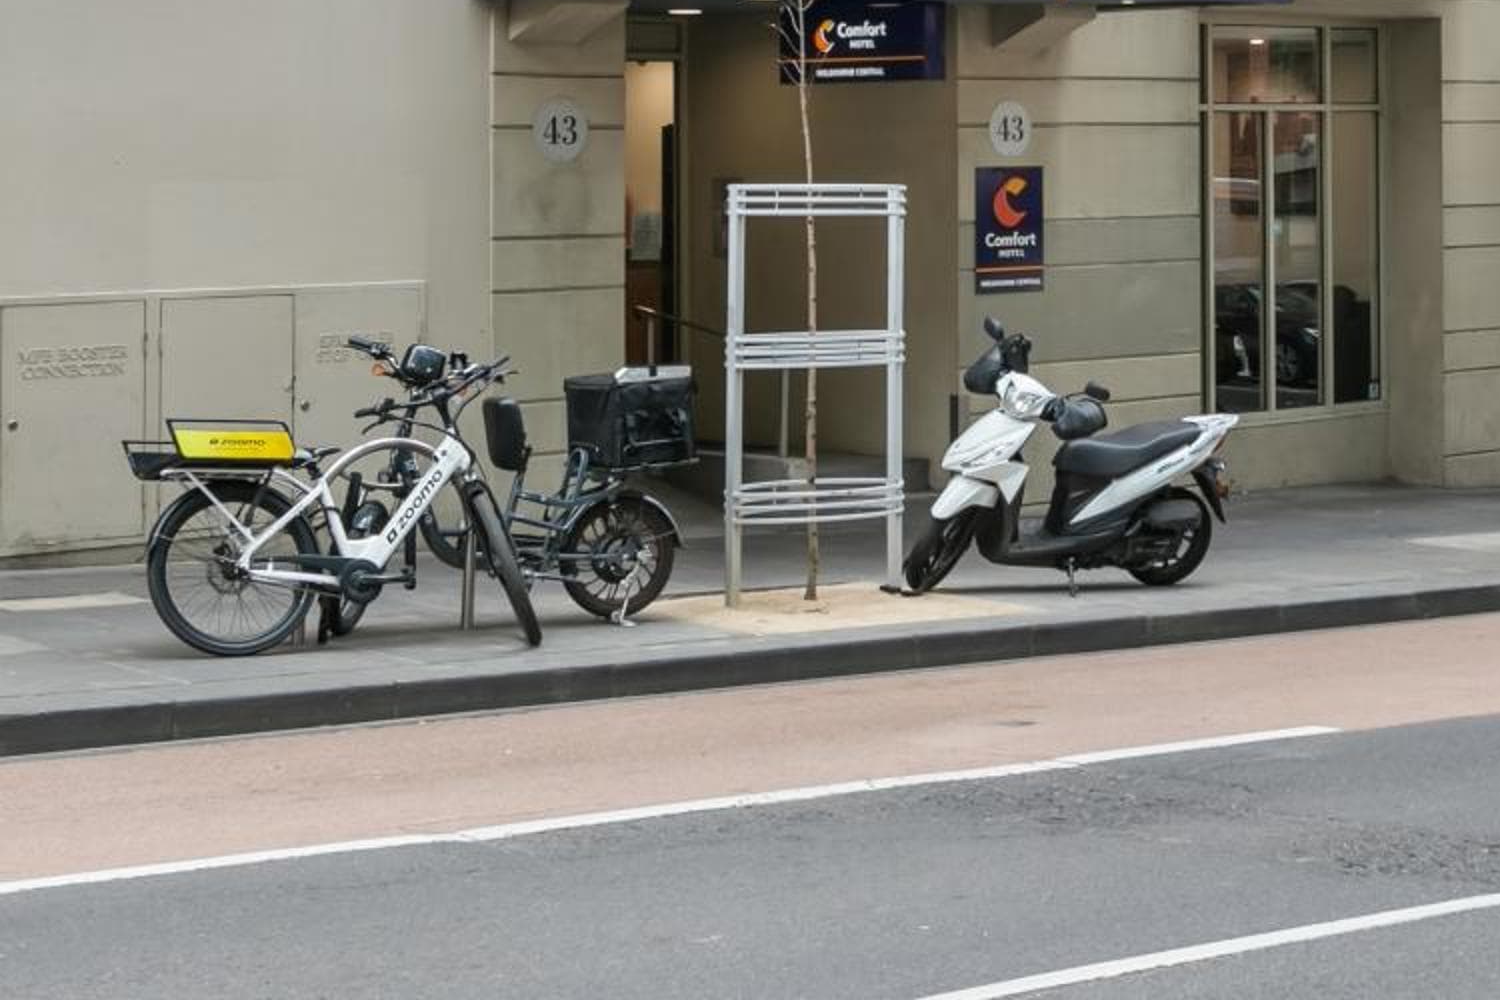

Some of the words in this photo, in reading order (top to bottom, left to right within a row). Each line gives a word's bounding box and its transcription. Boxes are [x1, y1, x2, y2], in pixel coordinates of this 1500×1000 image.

[836, 20, 887, 38] Comfort
[543, 114, 577, 145] 43
[996, 115, 1025, 142] 43
[985, 231, 1037, 247] Comfort
[398, 469, 443, 530] zoomo
